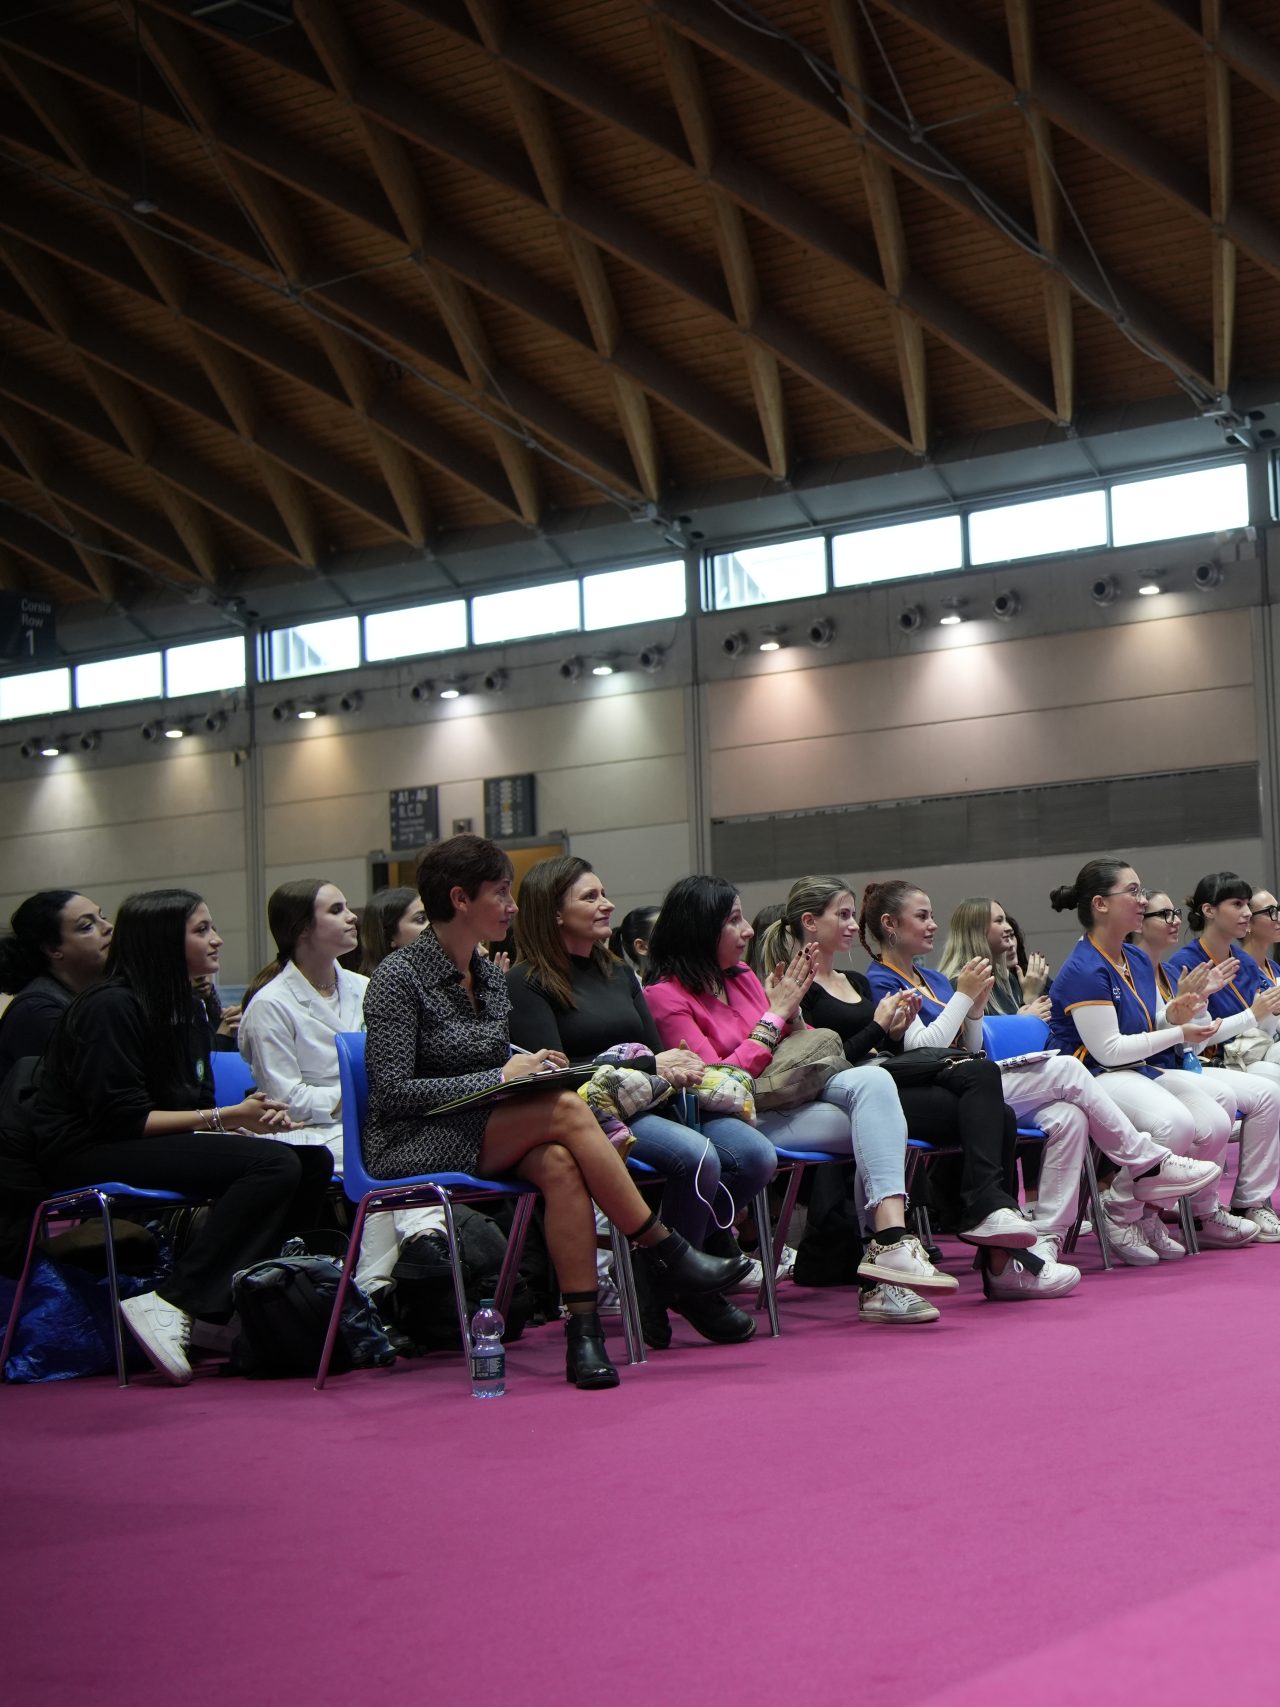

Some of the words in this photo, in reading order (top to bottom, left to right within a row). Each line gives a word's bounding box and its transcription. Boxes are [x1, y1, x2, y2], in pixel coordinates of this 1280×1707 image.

[21, 598, 52, 614] Corsia
[21, 613, 44, 627] Row
[26, 629, 34, 656] 1
